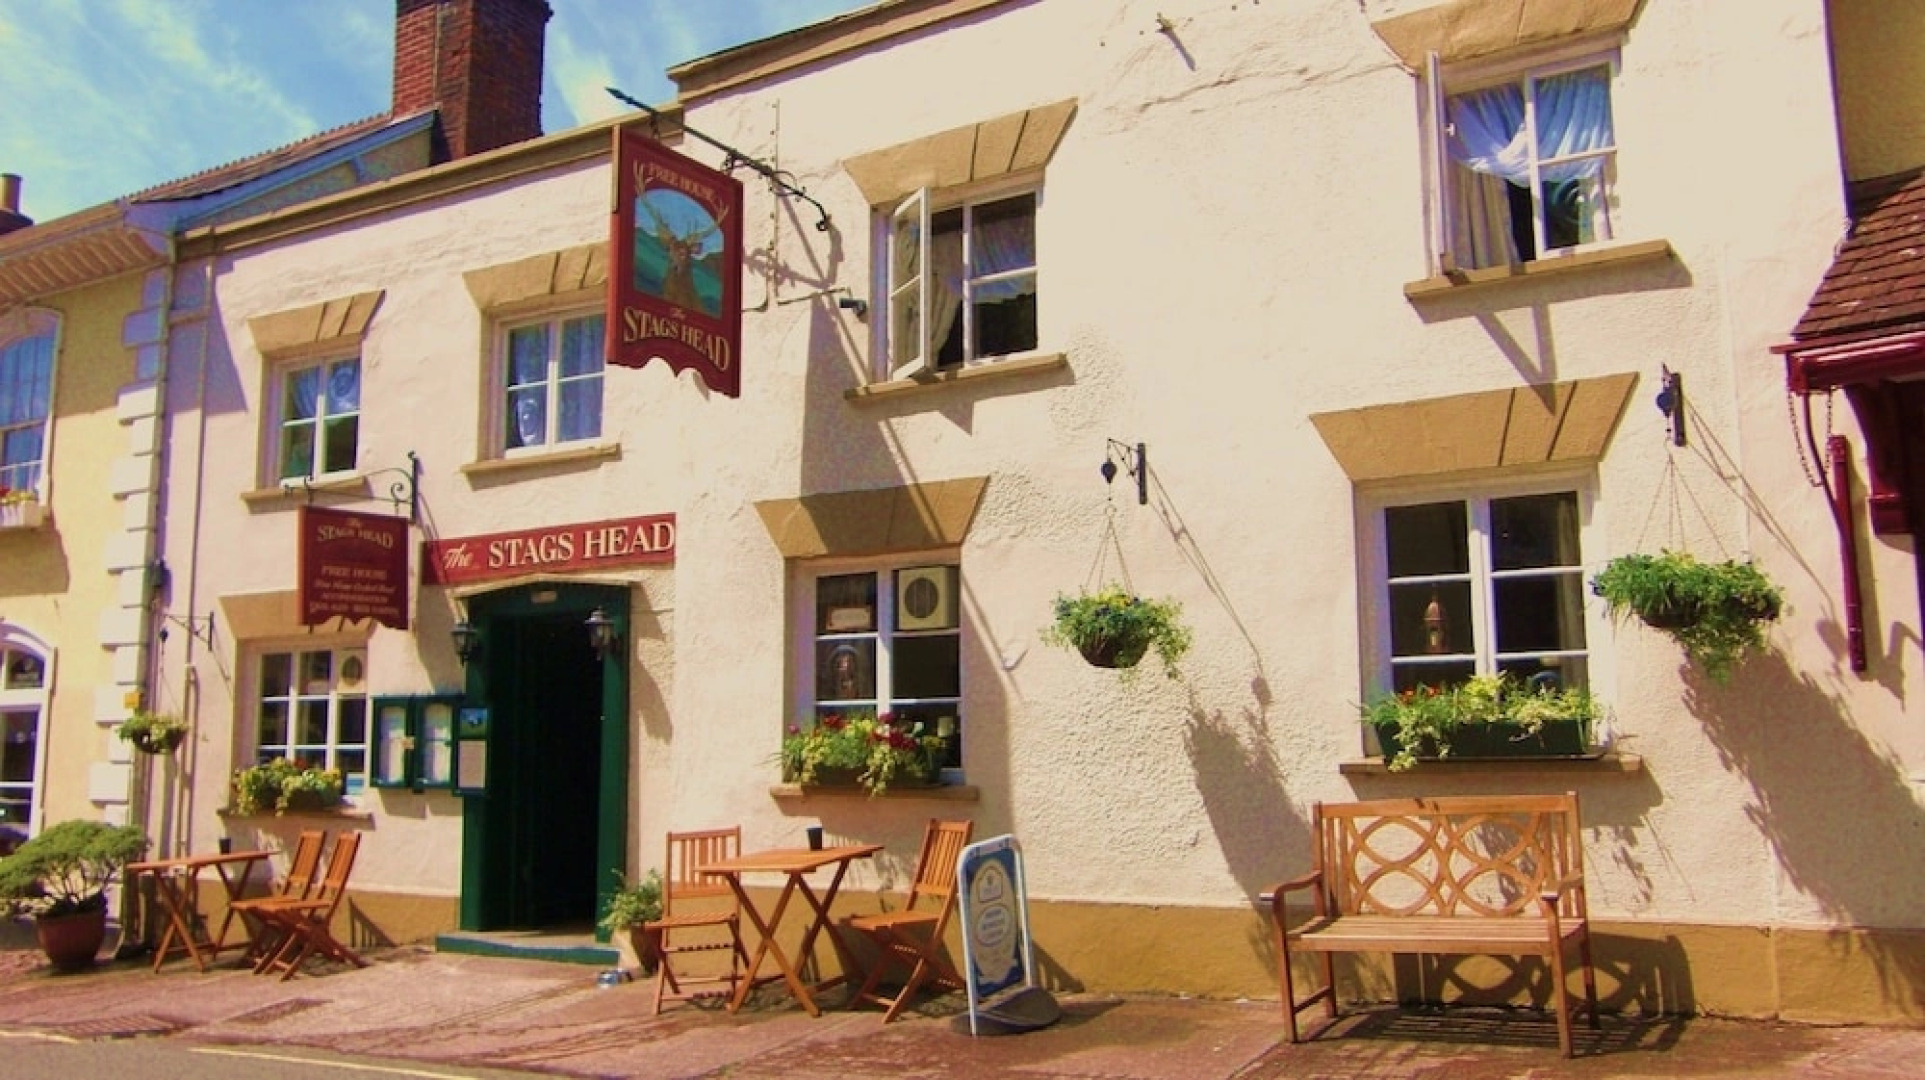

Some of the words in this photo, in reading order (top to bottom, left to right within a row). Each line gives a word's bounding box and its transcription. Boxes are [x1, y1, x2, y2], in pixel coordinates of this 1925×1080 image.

[648, 162, 680, 188] FREE
[680, 175, 716, 201] HOUSE
[623, 306, 680, 343] STAGS
[680, 324, 731, 372] HEAD
[316, 524, 356, 543] STAGS
[357, 528, 394, 549] HEAD
[442, 543, 473, 570] The
[488, 532, 575, 569] STAGS
[582, 521, 675, 559] HEAD
[321, 566, 351, 578] FREE
[353, 569, 387, 581] HOUSE
